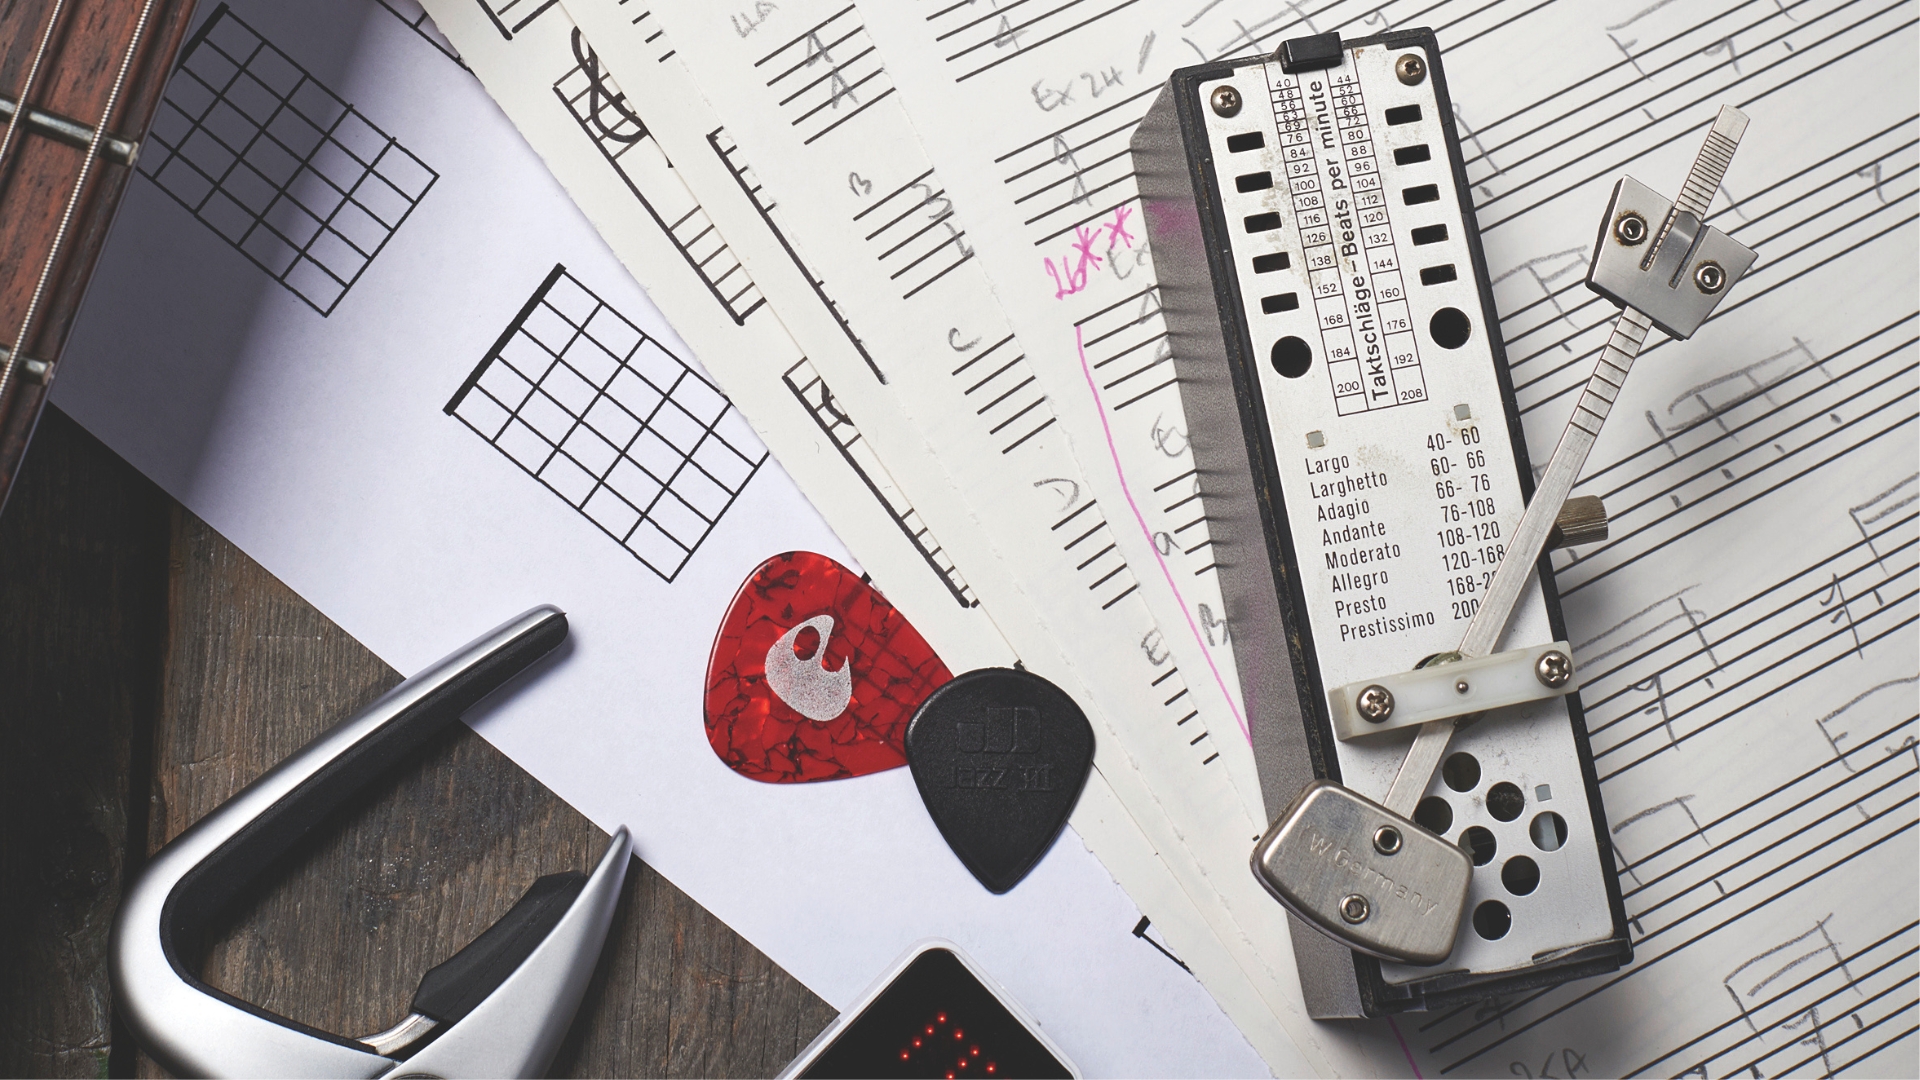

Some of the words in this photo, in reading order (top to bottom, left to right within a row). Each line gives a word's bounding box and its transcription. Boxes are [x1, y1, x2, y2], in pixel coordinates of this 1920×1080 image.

[1276, 79, 1291, 88] 40
[1337, 75, 1351, 84] 44
[1279, 90, 1294, 99] 48
[1339, 86, 1353, 95] 52
[1281, 101, 1296, 110] 56
[1341, 96, 1356, 105] 60
[1283, 111, 1298, 121] 63
[1309, 80, 1335, 149] minute
[1343, 106, 1358, 116] 66
[1346, 116, 1361, 125] 72
[1285, 121, 1300, 131] 69
[1287, 133, 1303, 143] 76
[1348, 130, 1364, 140] 80
[1290, 148, 1306, 158] 84
[1351, 146, 1367, 155] 88
[1293, 163, 1309, 173] 92
[1354, 162, 1370, 171] 96
[1326, 158, 1347, 190] per
[1295, 180, 1315, 191] 100
[1356, 178, 1376, 188] 104
[1299, 196, 1319, 208] 108
[1361, 195, 1378, 205] 112
[1303, 214, 1321, 225] 116
[1364, 211, 1383, 222] 120
[1306, 233, 1326, 243] 126
[1368, 233, 1388, 243] 132
[1311, 255, 1331, 266] 138
[1374, 258, 1393, 268] 144
[1317, 283, 1336, 294] 152
[1380, 288, 1399, 298] 160
[1324, 314, 1344, 324] 168
[1387, 319, 1406, 329] 176
[1331, 347, 1350, 358] 184
[1394, 353, 1413, 364] 192
[1337, 381, 1359, 393] 200
[1401, 389, 1423, 400] 208
[1305, 455, 1350, 475] Largo
[1461, 426, 1481, 446] 60
[1310, 471, 1388, 499] Larghetto
[1466, 450, 1486, 469] 66
[1317, 498, 1370, 522] Adagio
[1471, 473, 1491, 493] 76
[1322, 521, 1386, 546] Andante
[1441, 497, 1496, 523] 76-108
[1325, 542, 1401, 570] Moderato
[1437, 521, 1500, 548] 108-120
[1332, 570, 1389, 593] Allegro
[1442, 544, 1505, 572] 120-168
[1335, 595, 1387, 618] Presto
[1447, 570, 1497, 596] 168-2
[1339, 611, 1435, 642] Prestissimo
[1334, 848, 1438, 917] Germany
